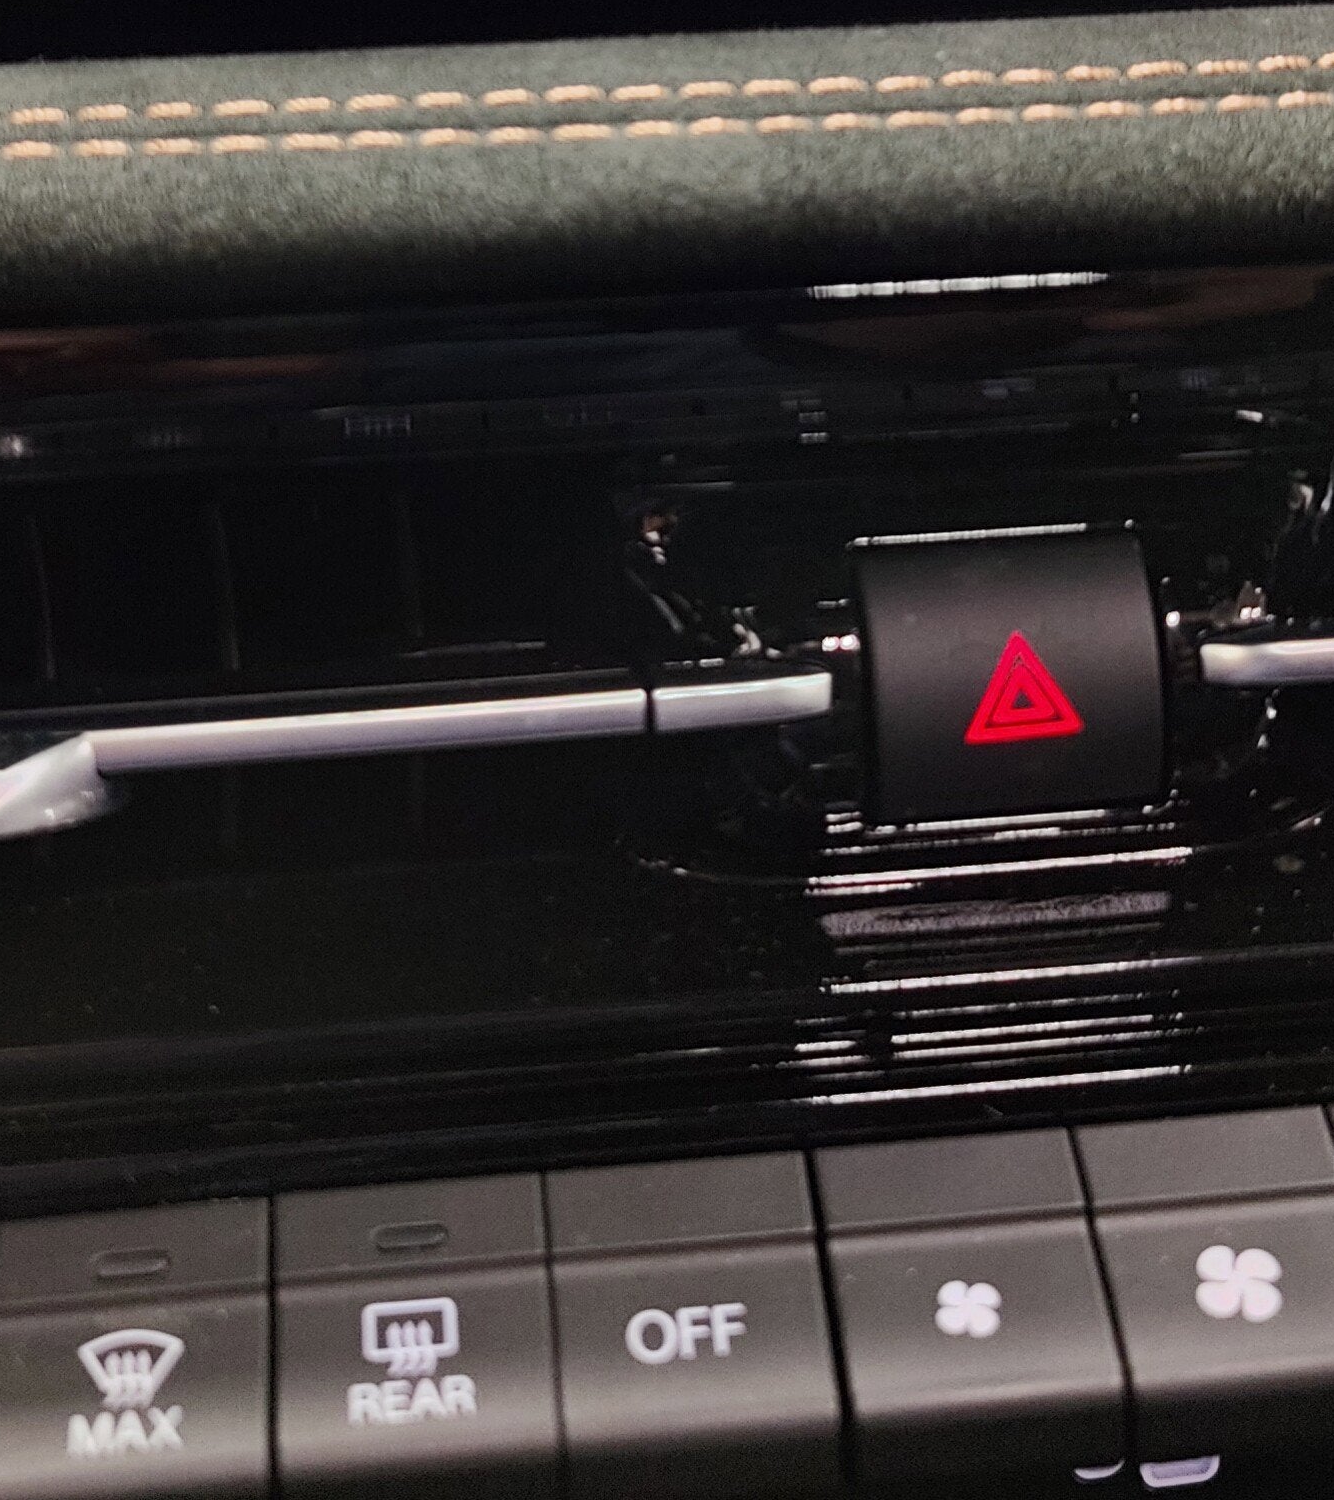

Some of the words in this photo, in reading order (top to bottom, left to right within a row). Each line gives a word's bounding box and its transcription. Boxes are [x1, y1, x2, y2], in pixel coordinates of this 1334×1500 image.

[624, 1302, 748, 1364] OFF
[347, 1374, 479, 1426] REAR
[69, 1405, 186, 1457] MAX
